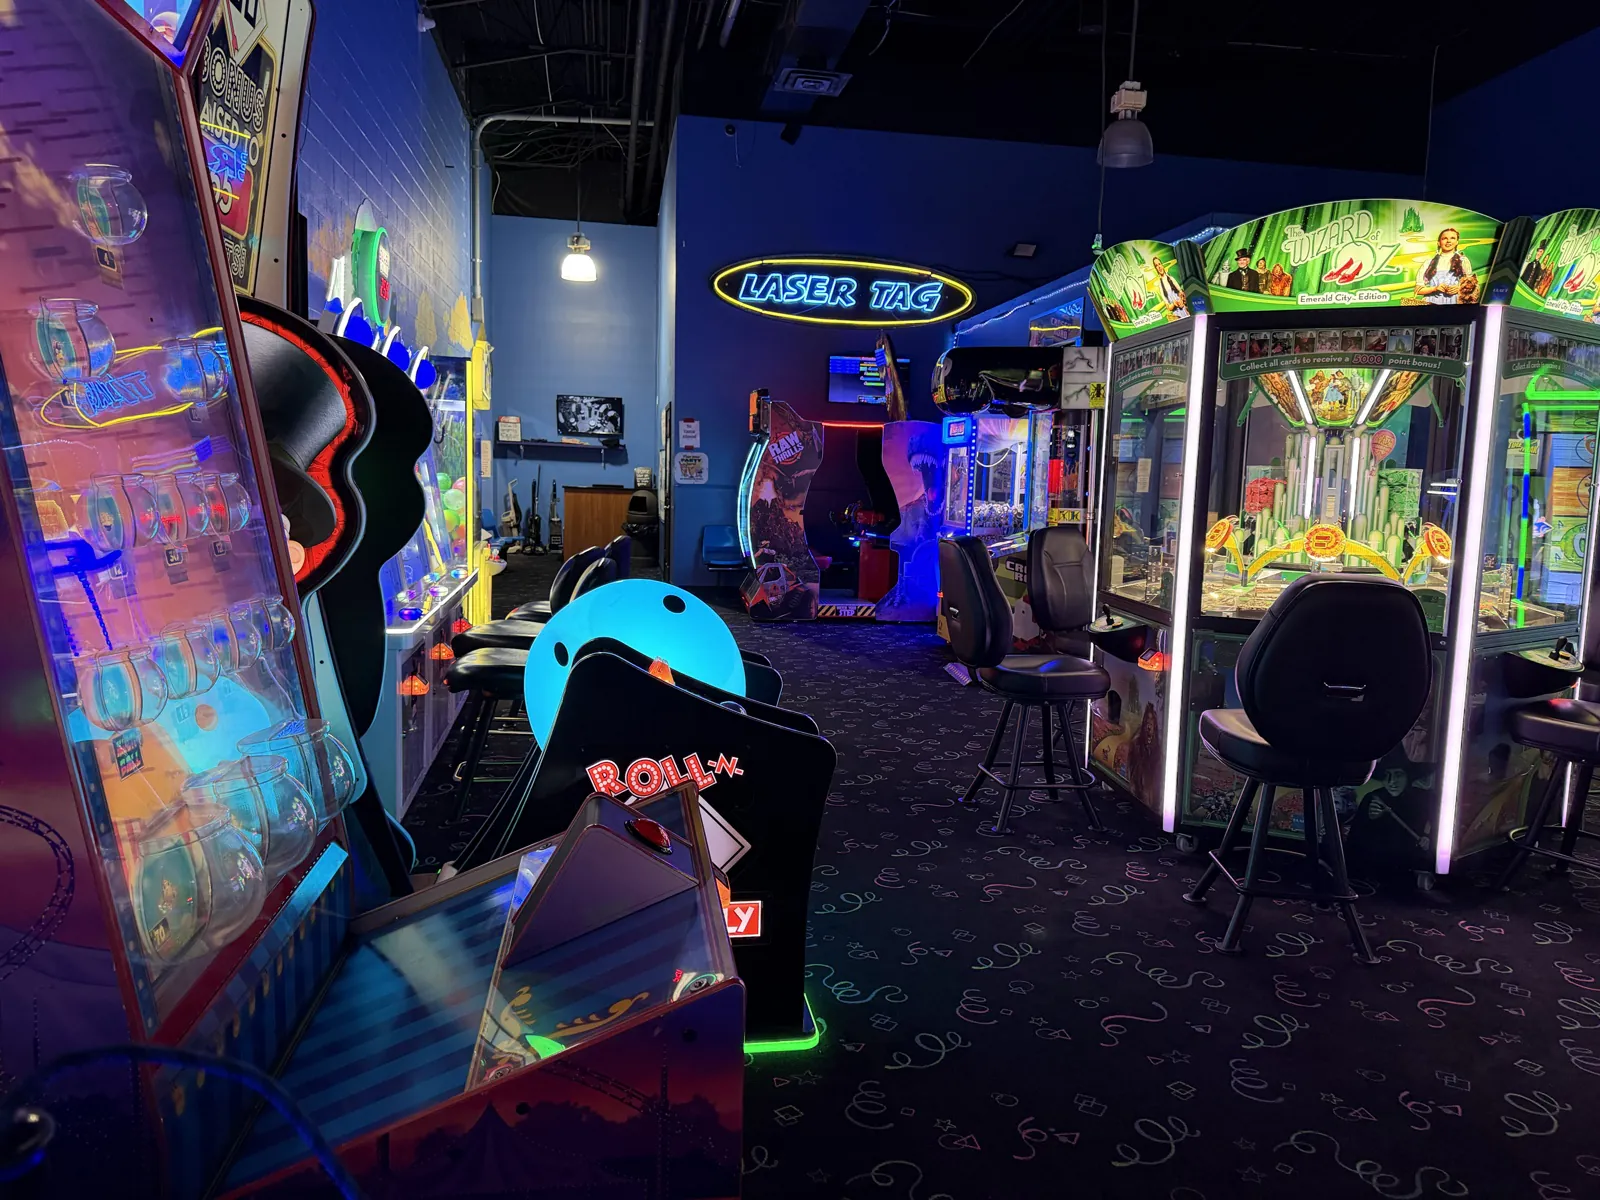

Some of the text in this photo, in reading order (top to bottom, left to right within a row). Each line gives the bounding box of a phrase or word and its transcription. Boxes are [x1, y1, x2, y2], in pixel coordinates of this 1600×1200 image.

[200, 95, 239, 149] AISED
[1284, 210, 1373, 265] WIZARD
[1335, 240, 1401, 280] OZ
[738, 272, 944, 313] LASER TAG
[1300, 293, 1388, 303] Emerald City Edition
[1240, 361, 1267, 372] Collect
[1269, 359, 1279, 367] all
[1280, 357, 1301, 366] cards
[1302, 356, 1311, 364] to
[1313, 355, 1343, 363] receive
[1352, 354, 1384, 364] 5000
[1388, 357, 1411, 365] point
[1412, 358, 1442, 369] bonus!
[768, 431, 802, 458] RAW
[773, 442, 805, 464] THRILLS
